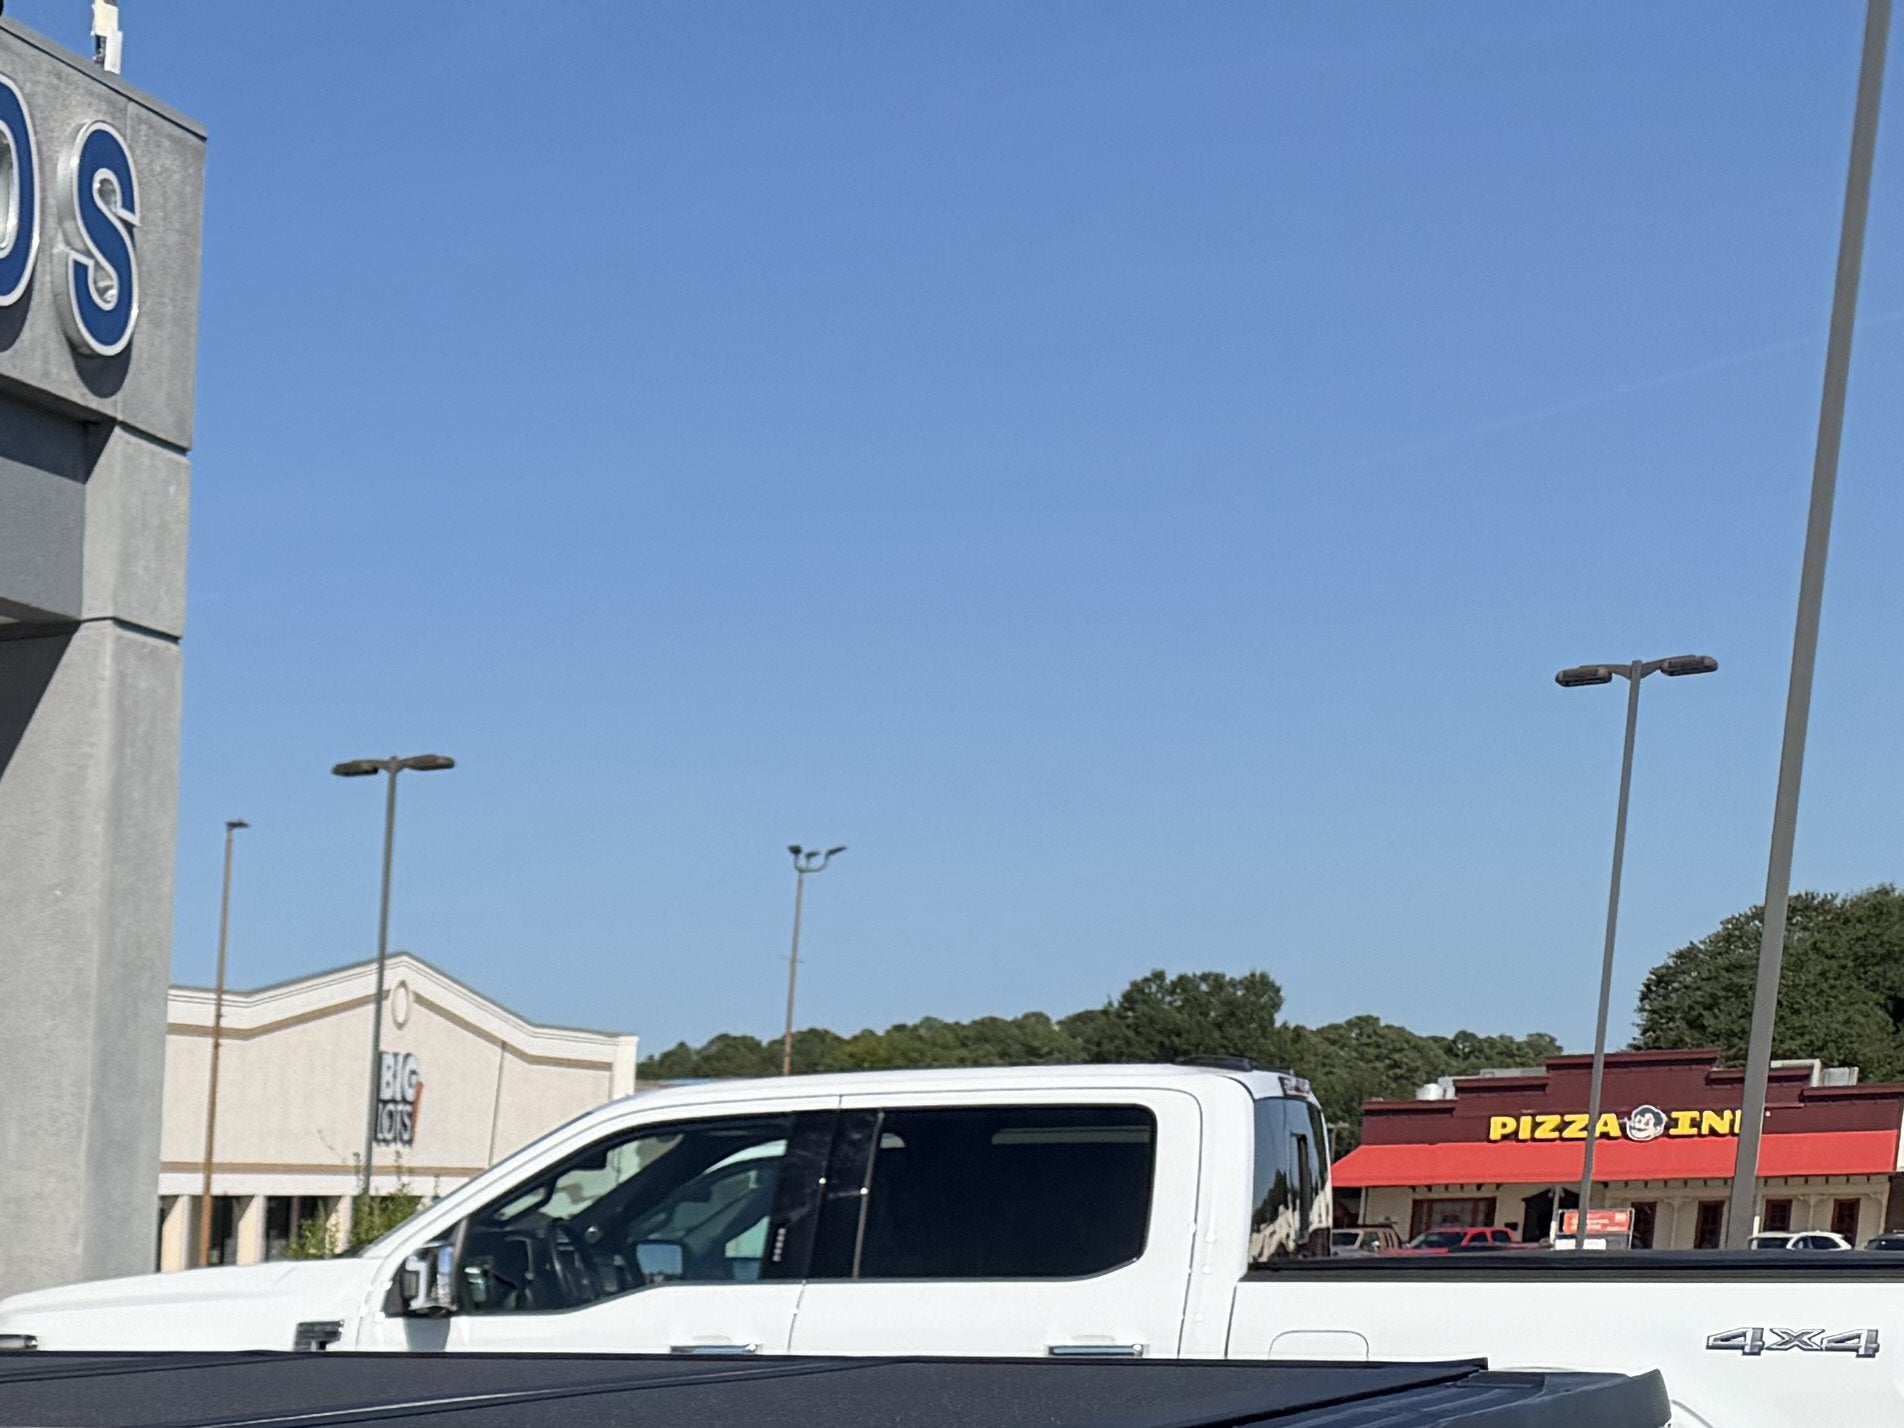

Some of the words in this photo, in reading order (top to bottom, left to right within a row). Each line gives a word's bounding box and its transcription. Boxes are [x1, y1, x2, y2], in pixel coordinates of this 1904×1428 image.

[378, 1052, 420, 1102] BIG
[375, 1102, 414, 1141] LOTS
[1488, 1113, 1622, 1141] PIZZA
